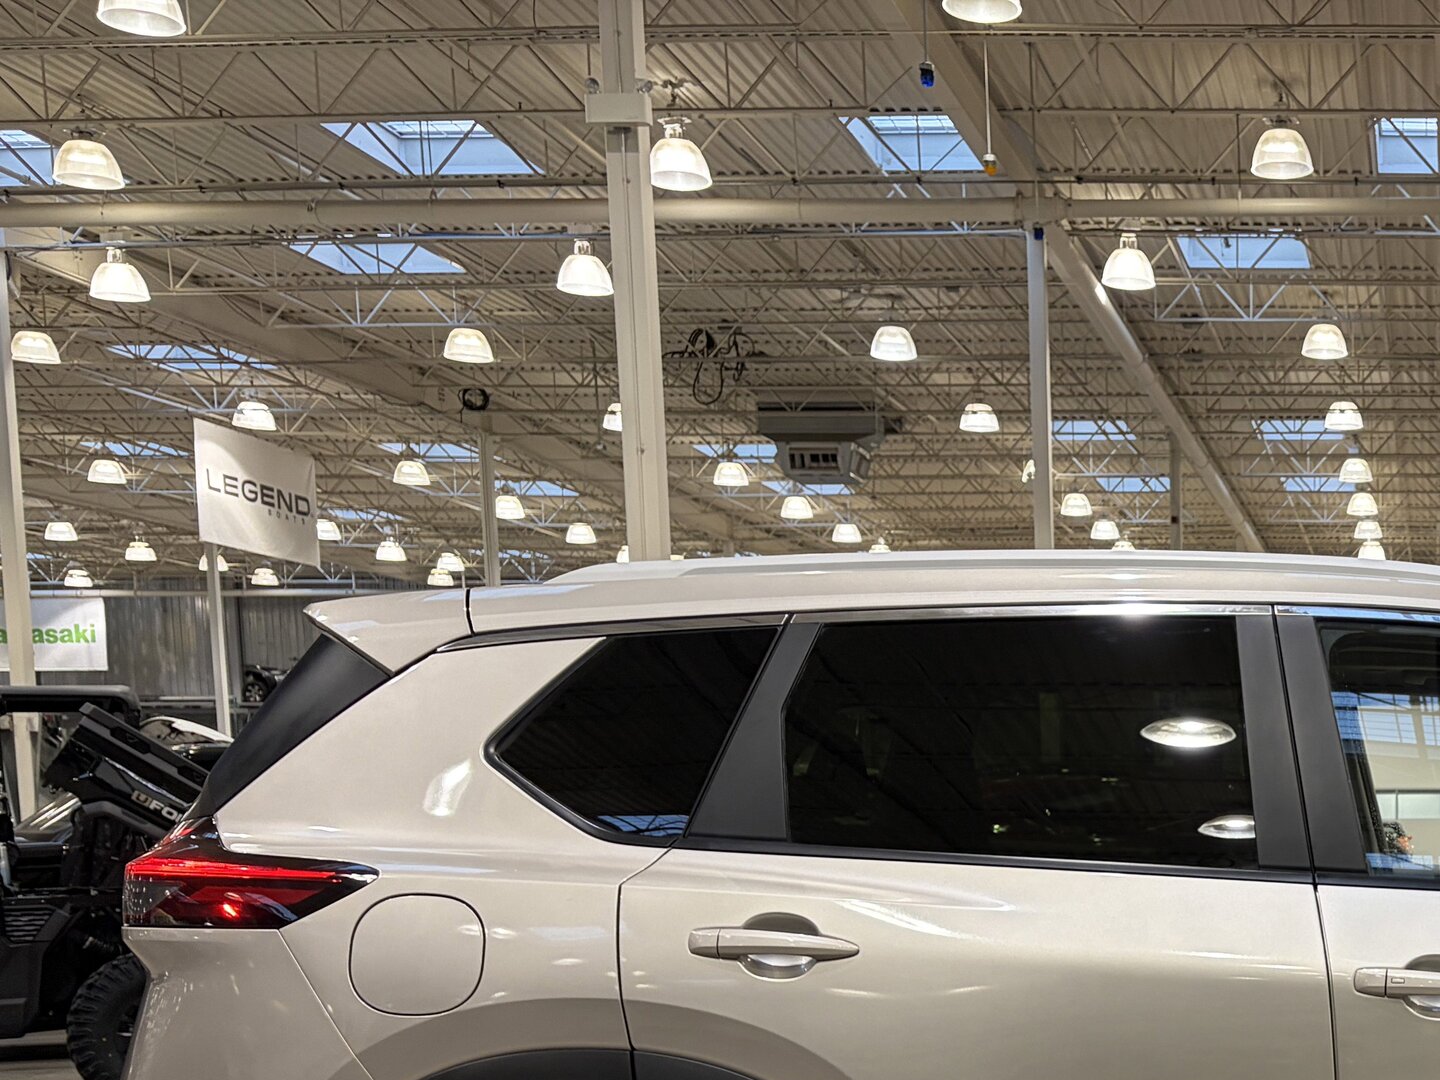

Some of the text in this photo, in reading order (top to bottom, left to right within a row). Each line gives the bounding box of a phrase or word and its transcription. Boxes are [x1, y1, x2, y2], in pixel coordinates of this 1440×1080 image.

[206, 468, 311, 516] LEGEND
[0, 624, 96, 644] aasaki
[131, 790, 183, 823] UFO
